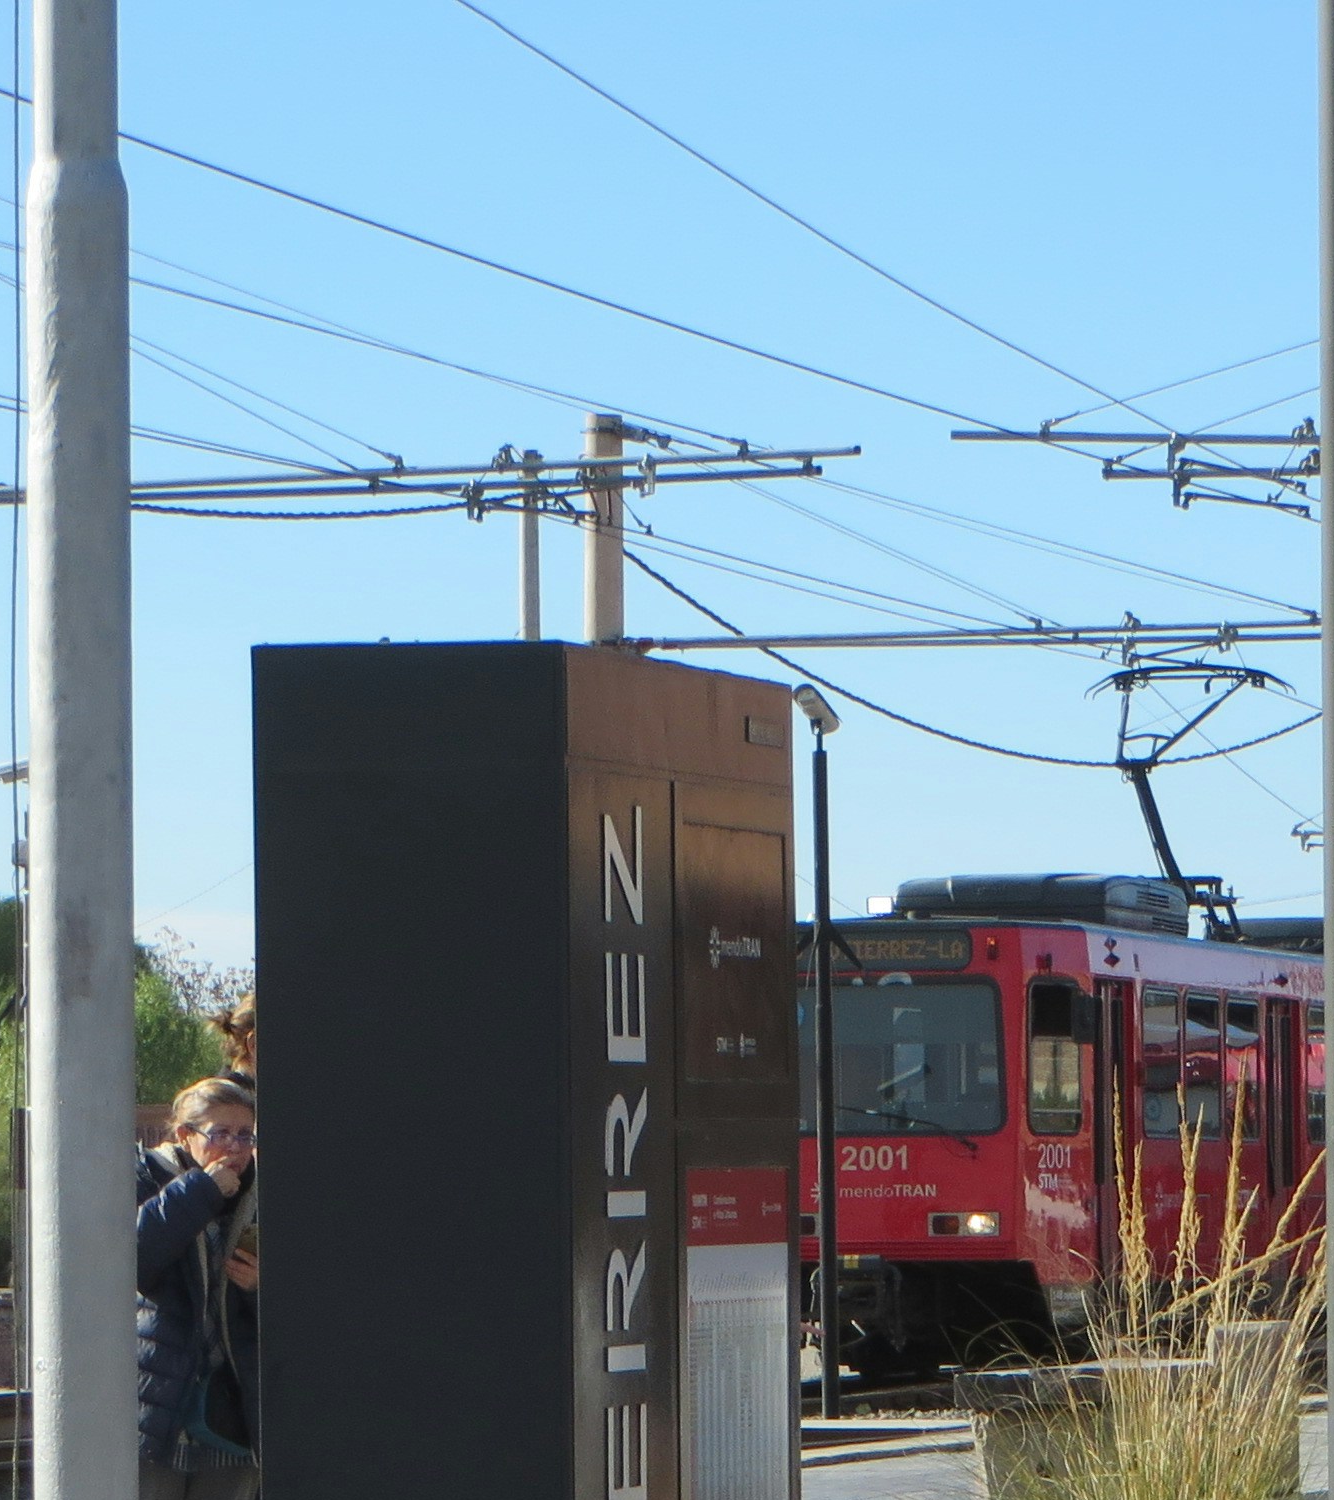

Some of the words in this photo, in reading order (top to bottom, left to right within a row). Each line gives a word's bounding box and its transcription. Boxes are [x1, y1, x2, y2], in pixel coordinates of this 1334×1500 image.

[840, 1145, 908, 1171] 2001
[1038, 1143, 1071, 1169] 2001
[839, 1184, 937, 1198] mendoTRAN
[1038, 1173, 1058, 1190] STM
